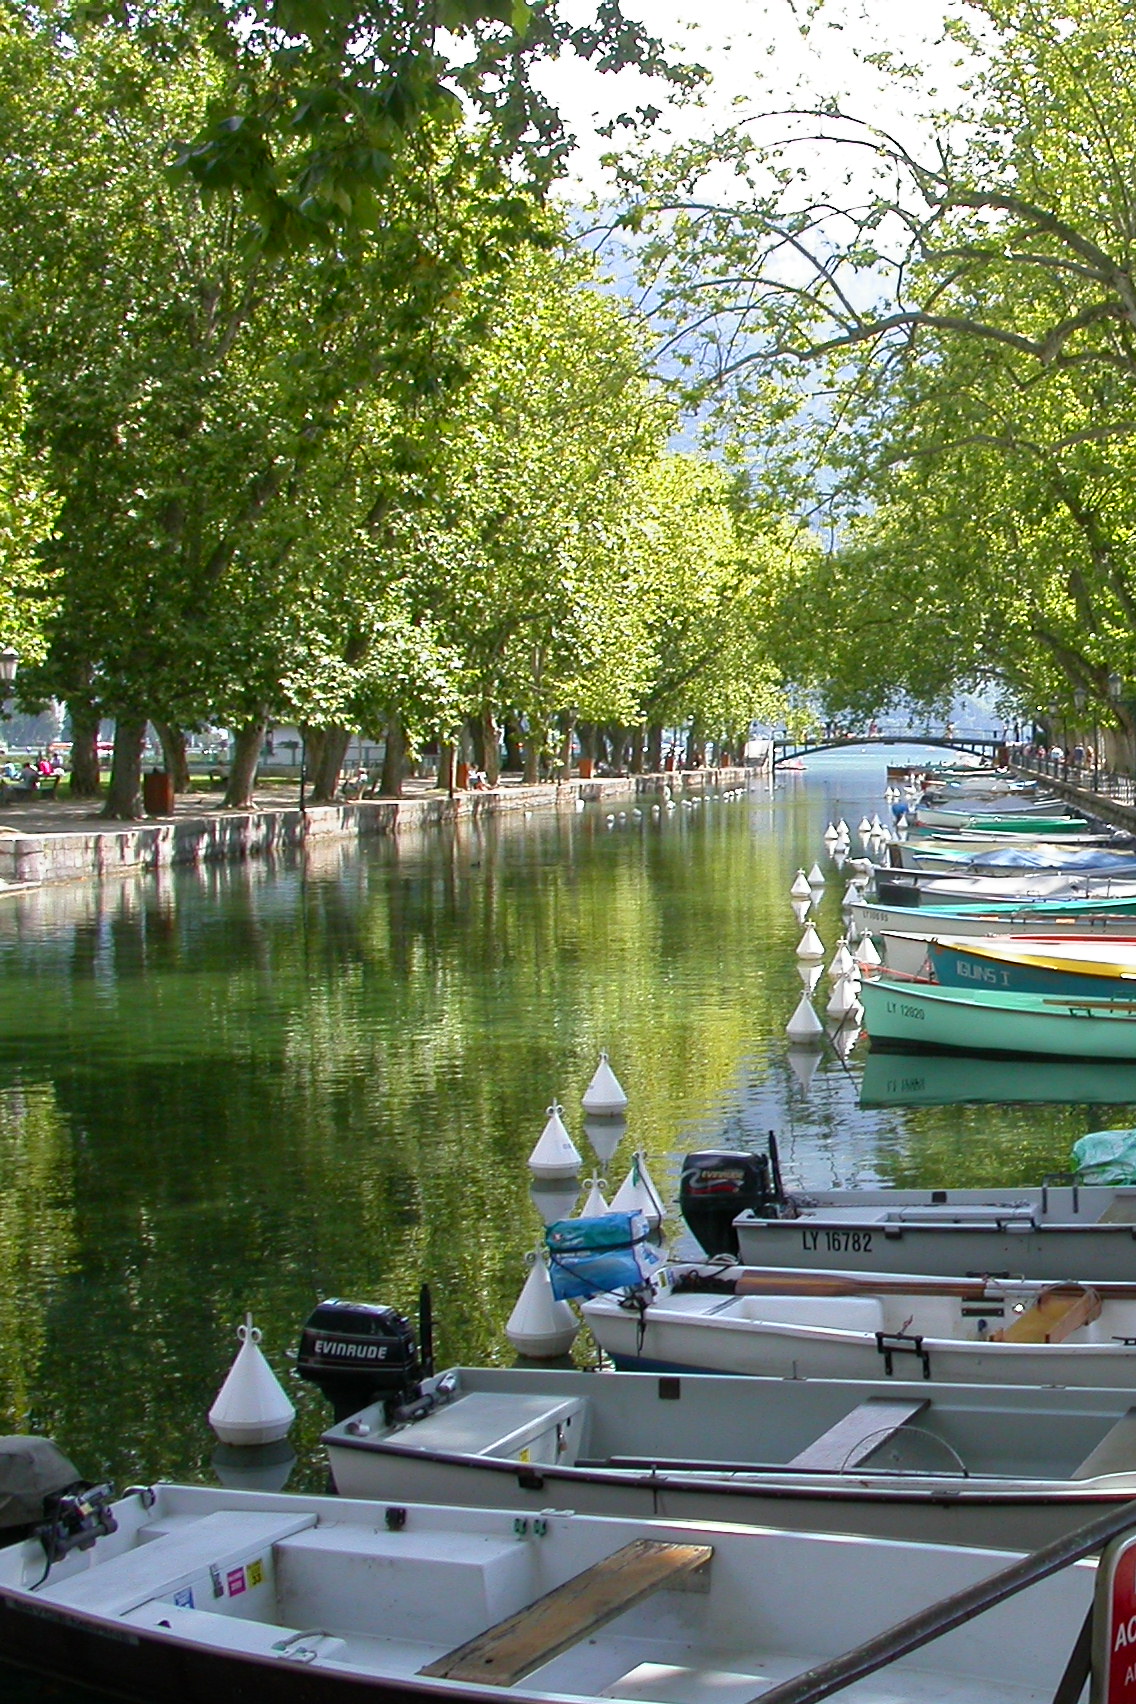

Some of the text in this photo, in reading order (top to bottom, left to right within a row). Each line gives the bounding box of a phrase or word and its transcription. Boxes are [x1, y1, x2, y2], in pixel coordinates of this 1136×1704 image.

[886, 1001, 897, 1014] LY
[802, 1230, 873, 1253] LY 16782
[314, 1340, 388, 1360] EVINRUDE
